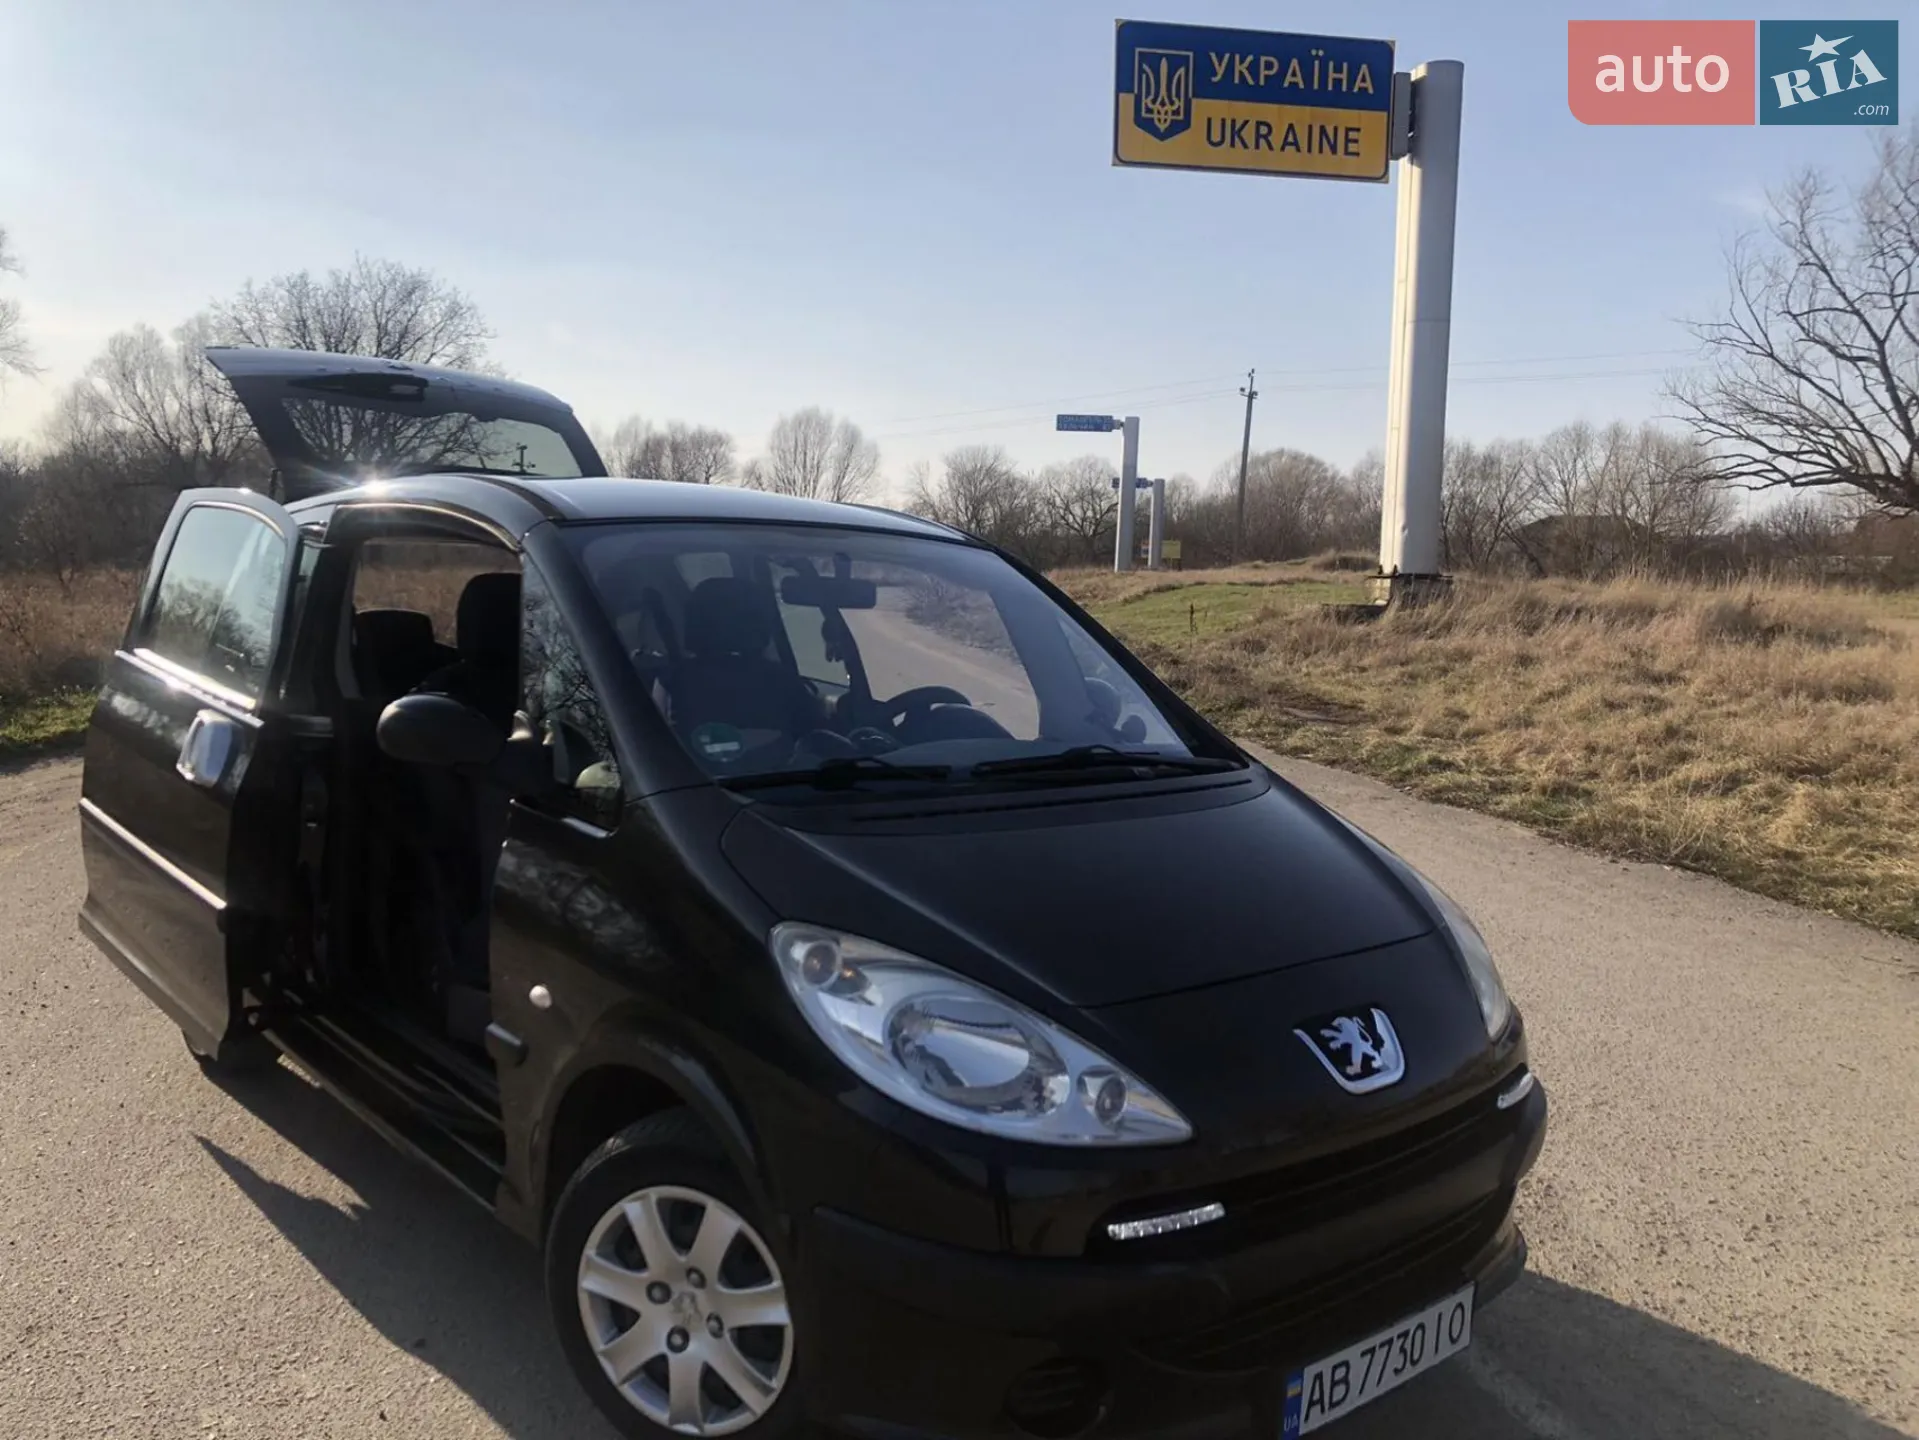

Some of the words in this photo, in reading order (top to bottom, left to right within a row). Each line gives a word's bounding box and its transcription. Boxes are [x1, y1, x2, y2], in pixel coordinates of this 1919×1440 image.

[1209, 49, 1374, 94] УКРАЇНА
[1206, 117, 1362, 157] UKRAINE
[1283, 1414, 1299, 1432] UA
